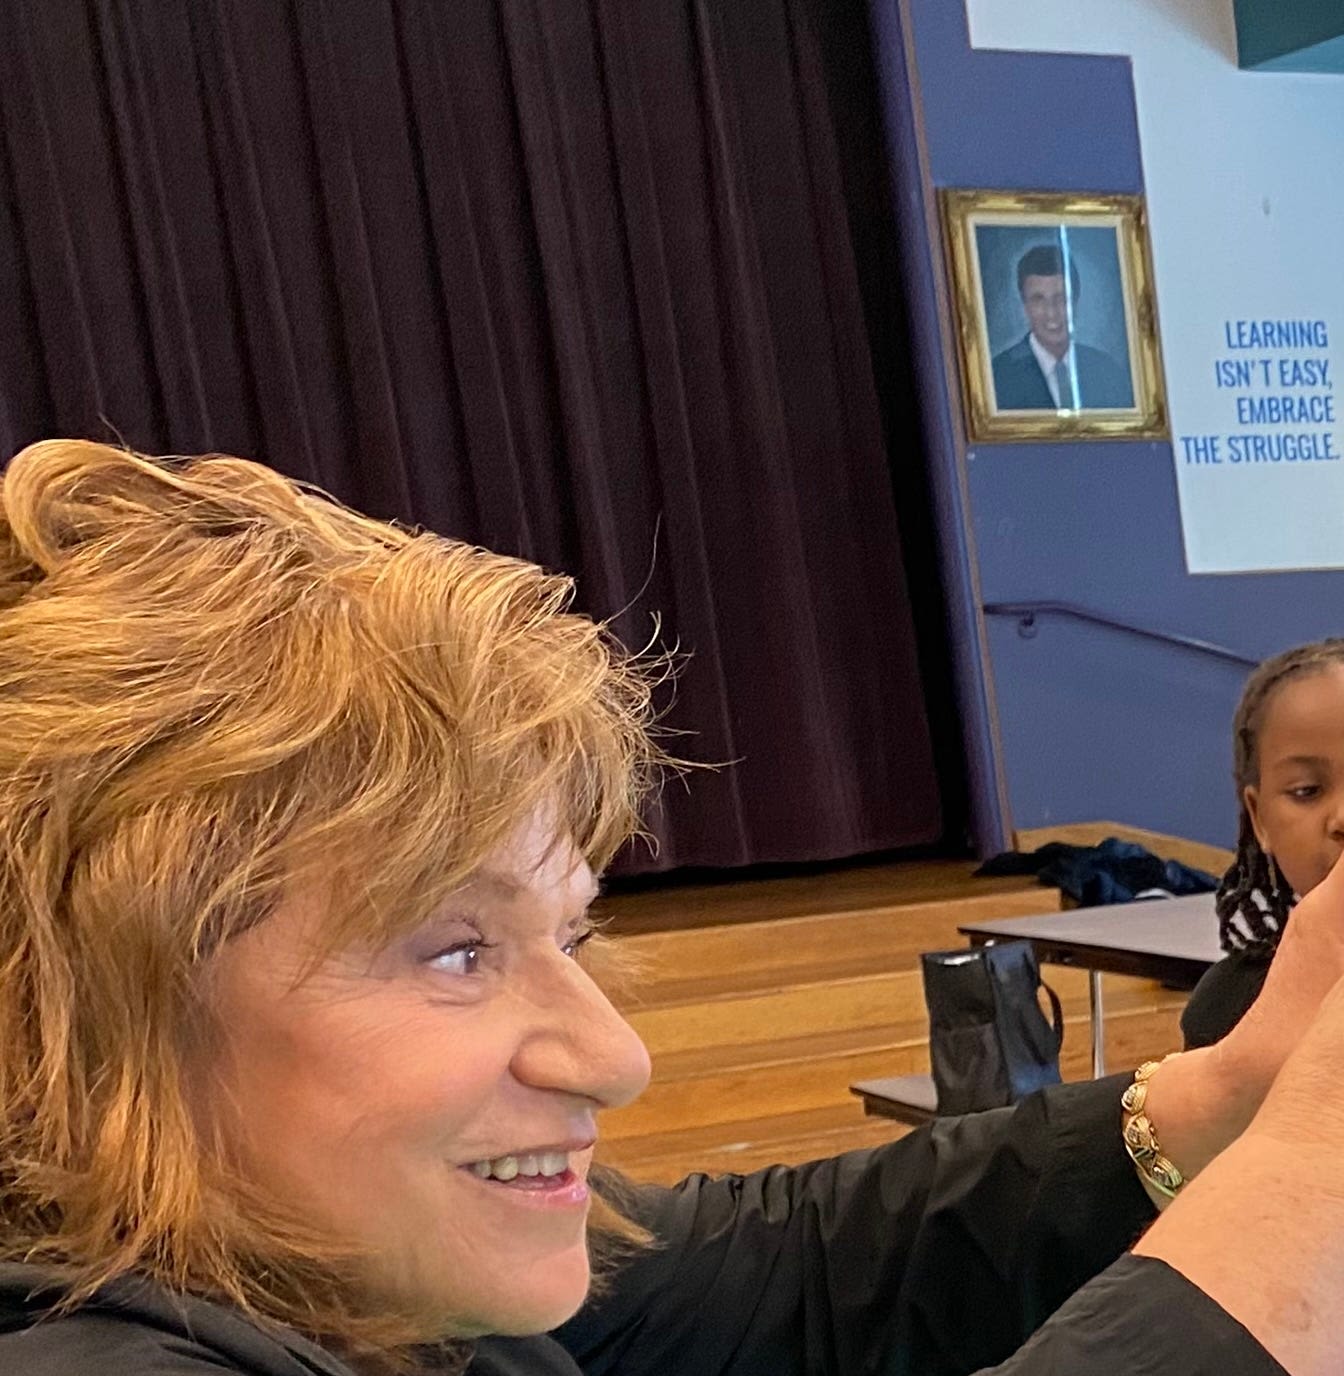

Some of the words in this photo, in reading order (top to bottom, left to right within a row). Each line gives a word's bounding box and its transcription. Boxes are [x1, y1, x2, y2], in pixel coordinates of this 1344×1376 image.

[1226, 320, 1329, 349] LEARNING
[1216, 359, 1272, 388] ISN'T
[1279, 359, 1333, 390] EASY,
[1237, 396, 1335, 425] EMBRACE
[1180, 436, 1222, 464] THE
[1227, 433, 1340, 463] STRUGGLE.
